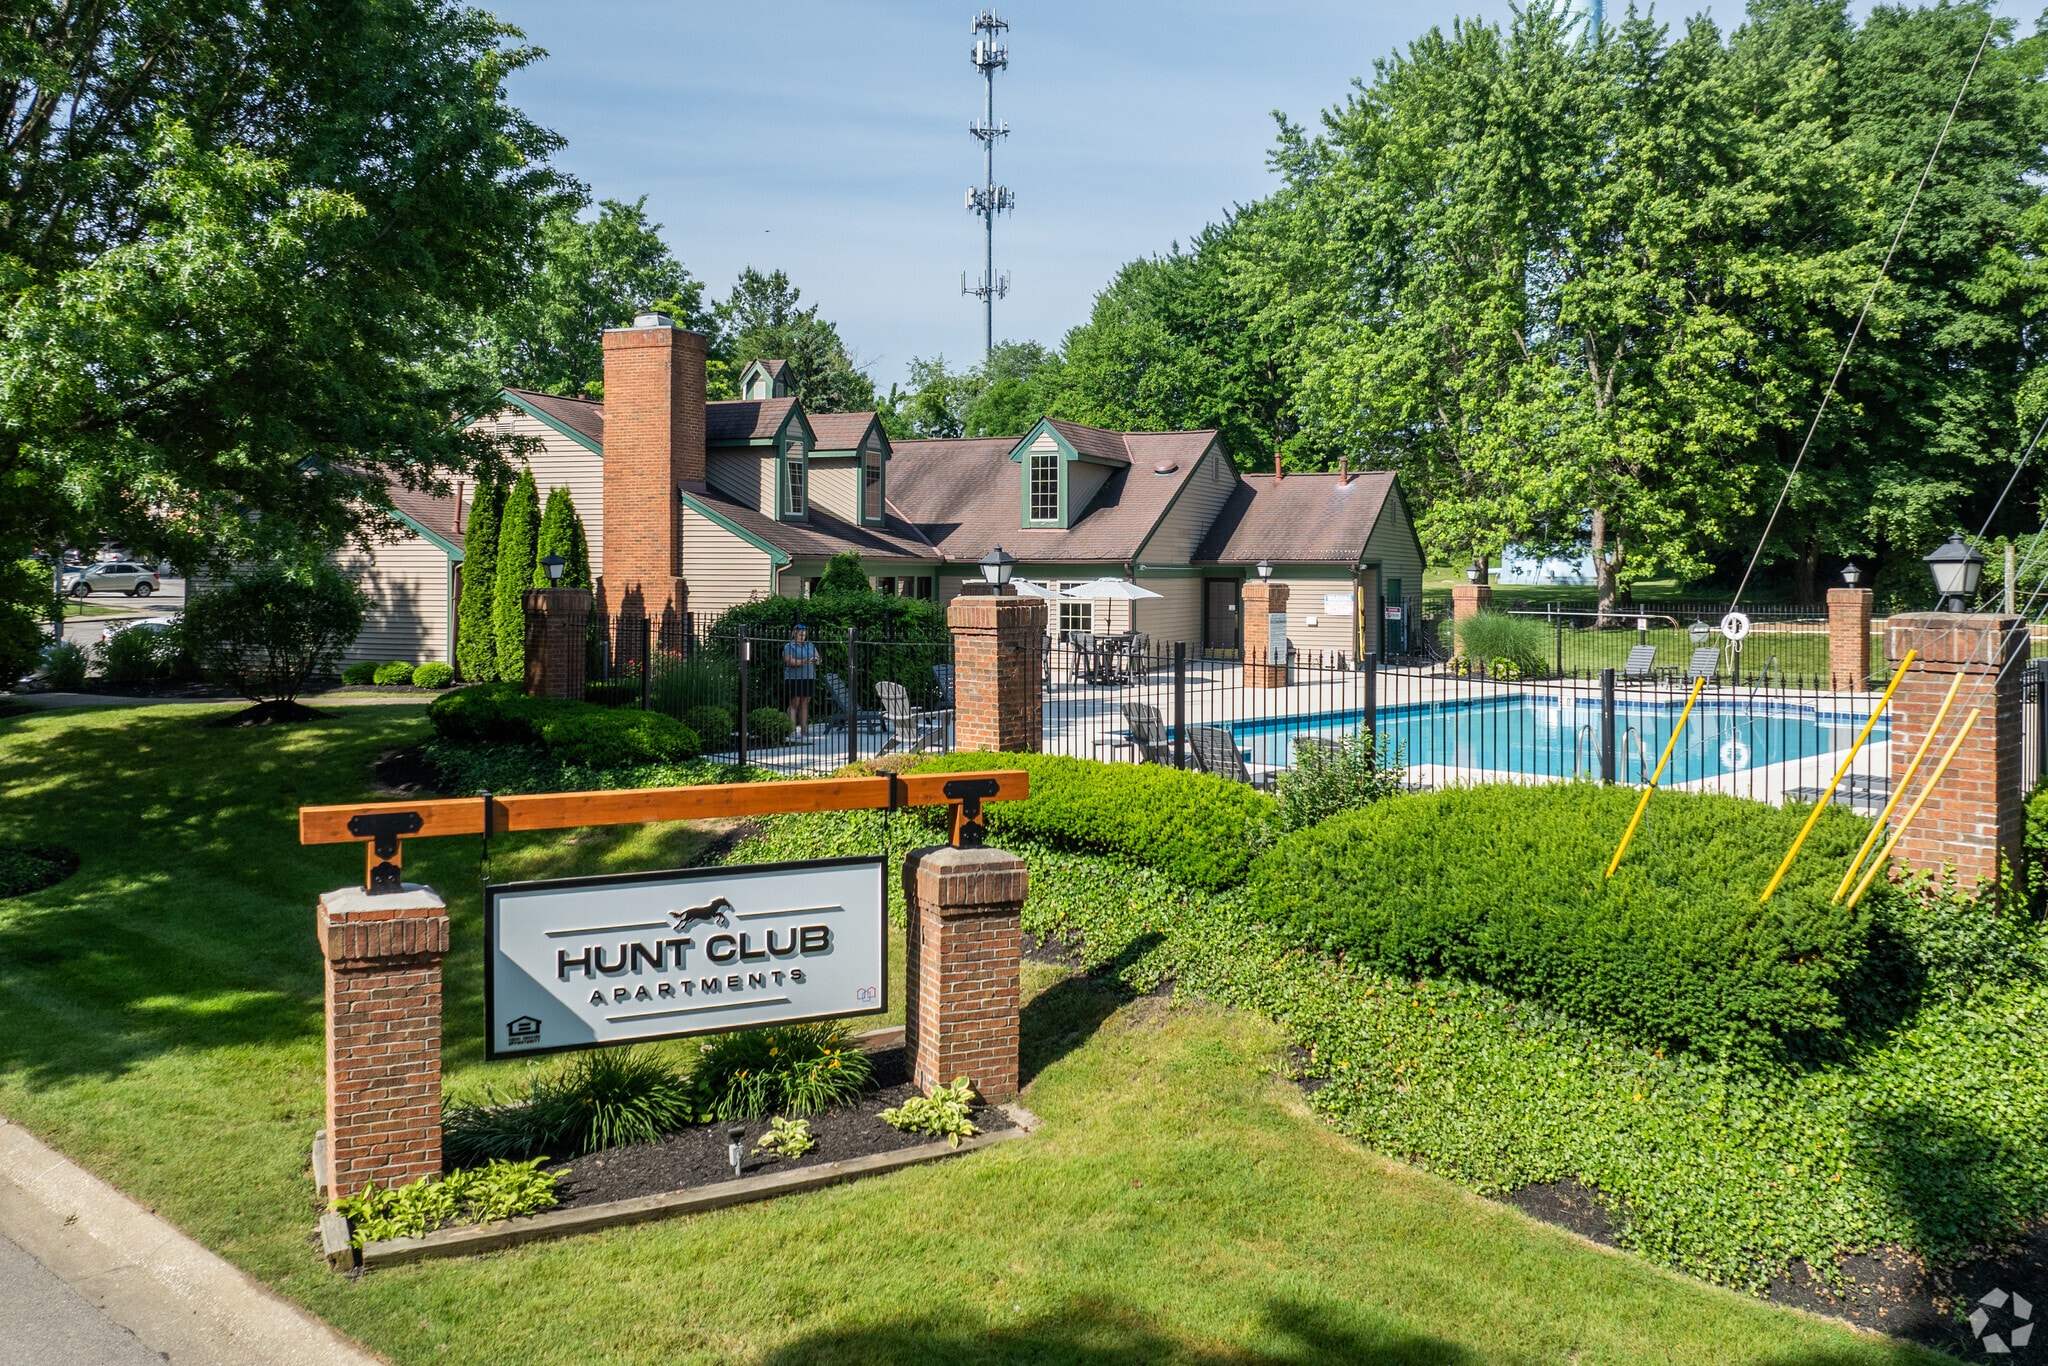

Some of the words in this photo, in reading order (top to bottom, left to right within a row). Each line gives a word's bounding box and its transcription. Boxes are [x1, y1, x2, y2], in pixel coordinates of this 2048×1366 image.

[557, 937, 692, 979] HUNT
[705, 925, 831, 963] CLUB
[589, 968, 803, 1003] APARTMENTS
